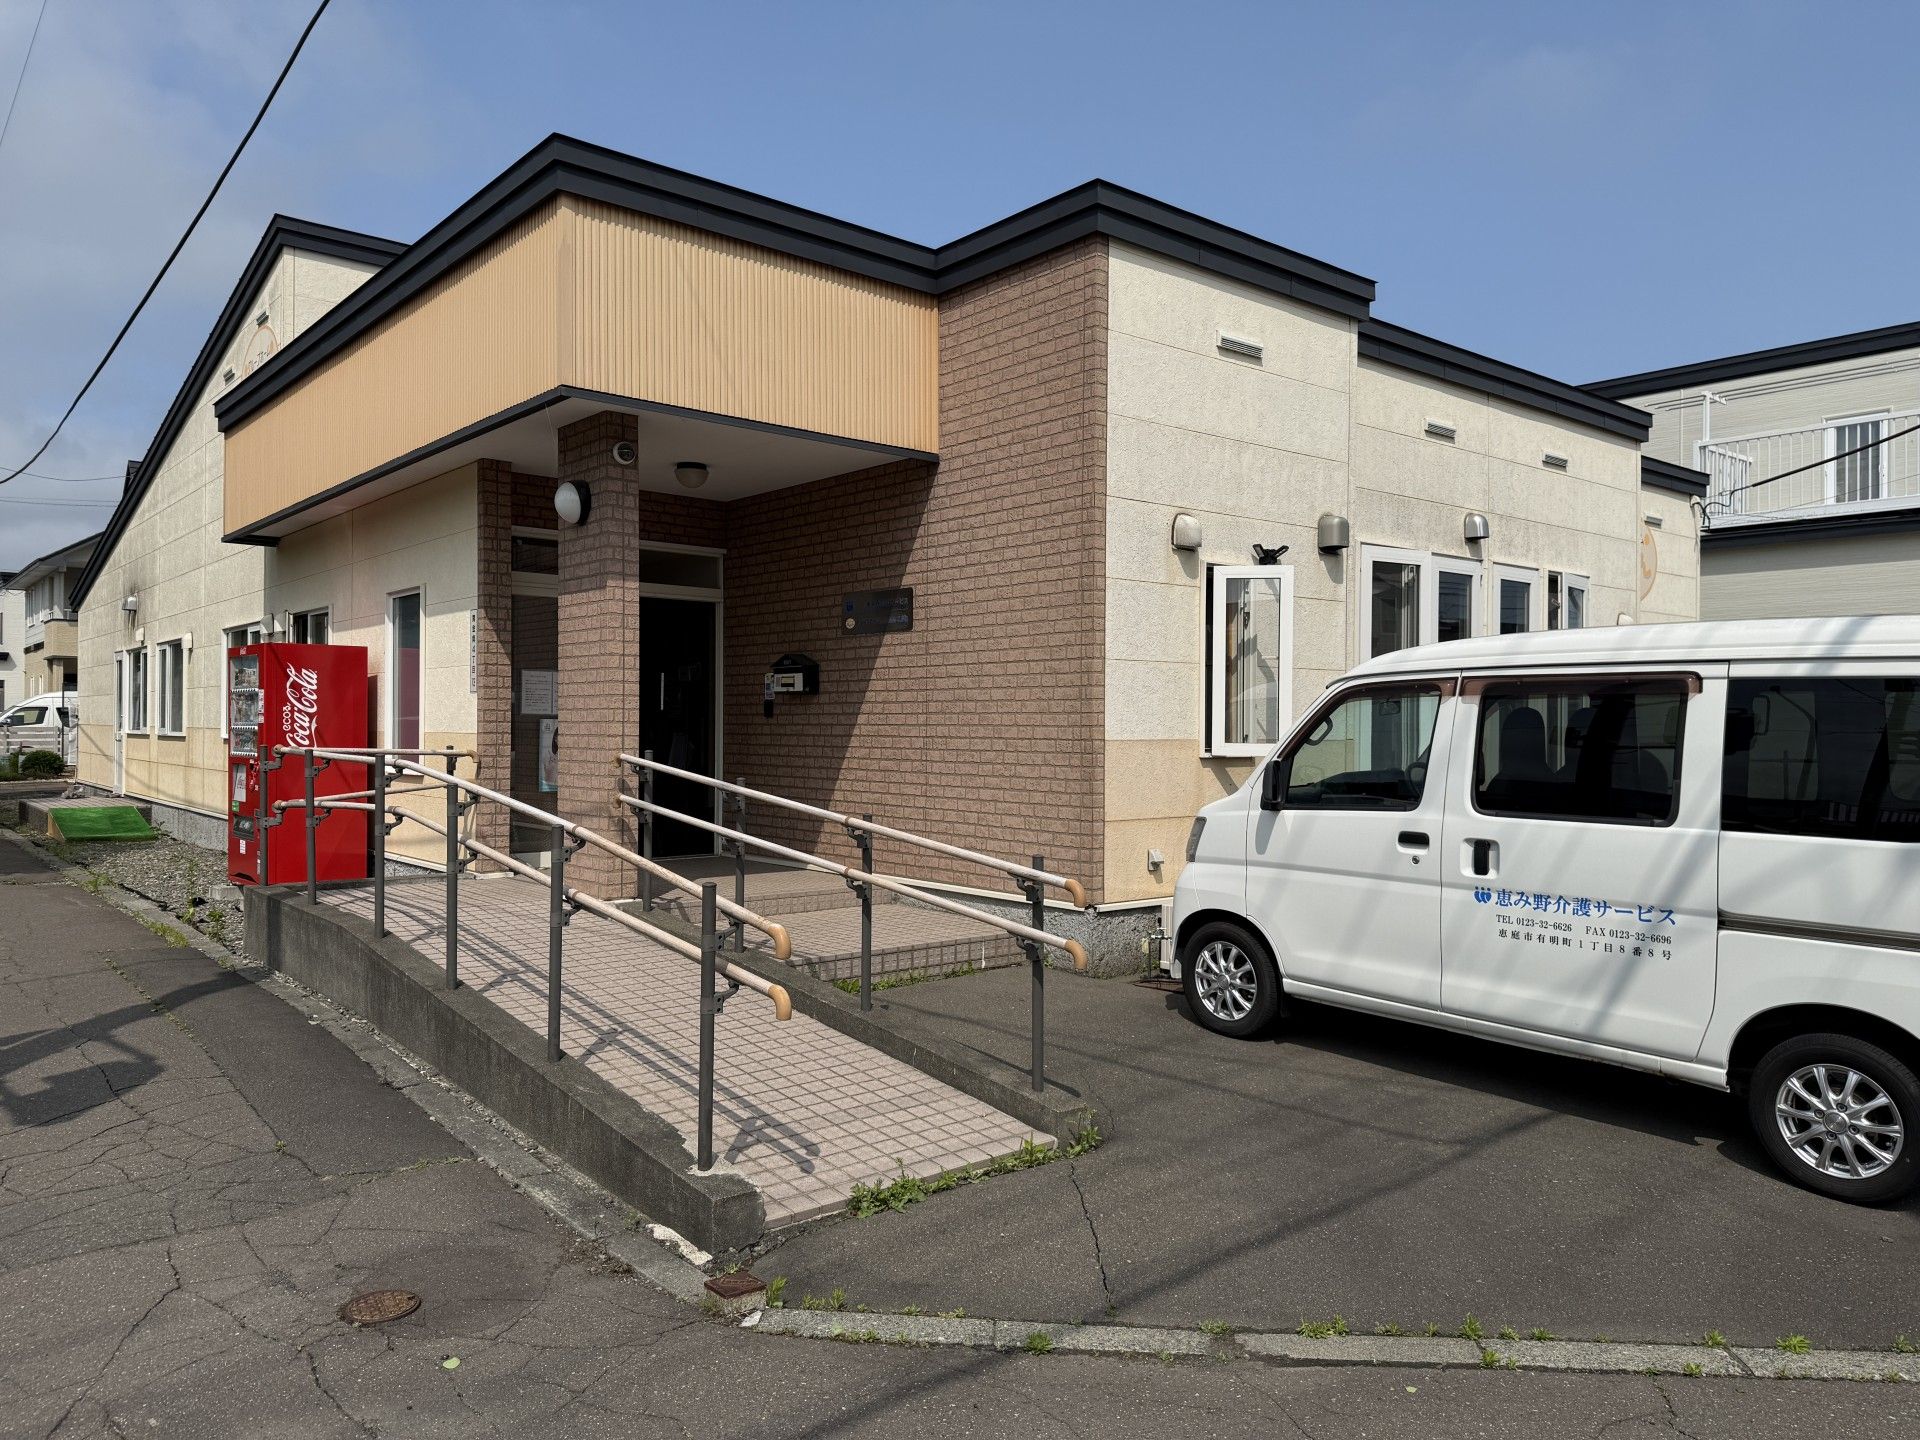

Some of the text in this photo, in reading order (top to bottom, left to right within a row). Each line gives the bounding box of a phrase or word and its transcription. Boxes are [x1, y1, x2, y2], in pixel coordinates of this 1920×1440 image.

[1495, 888, 1676, 926] 恵み野介護サービス
[1496, 914, 1672, 944] TEL 0123-32-6626 FAX 0123-32-6696
